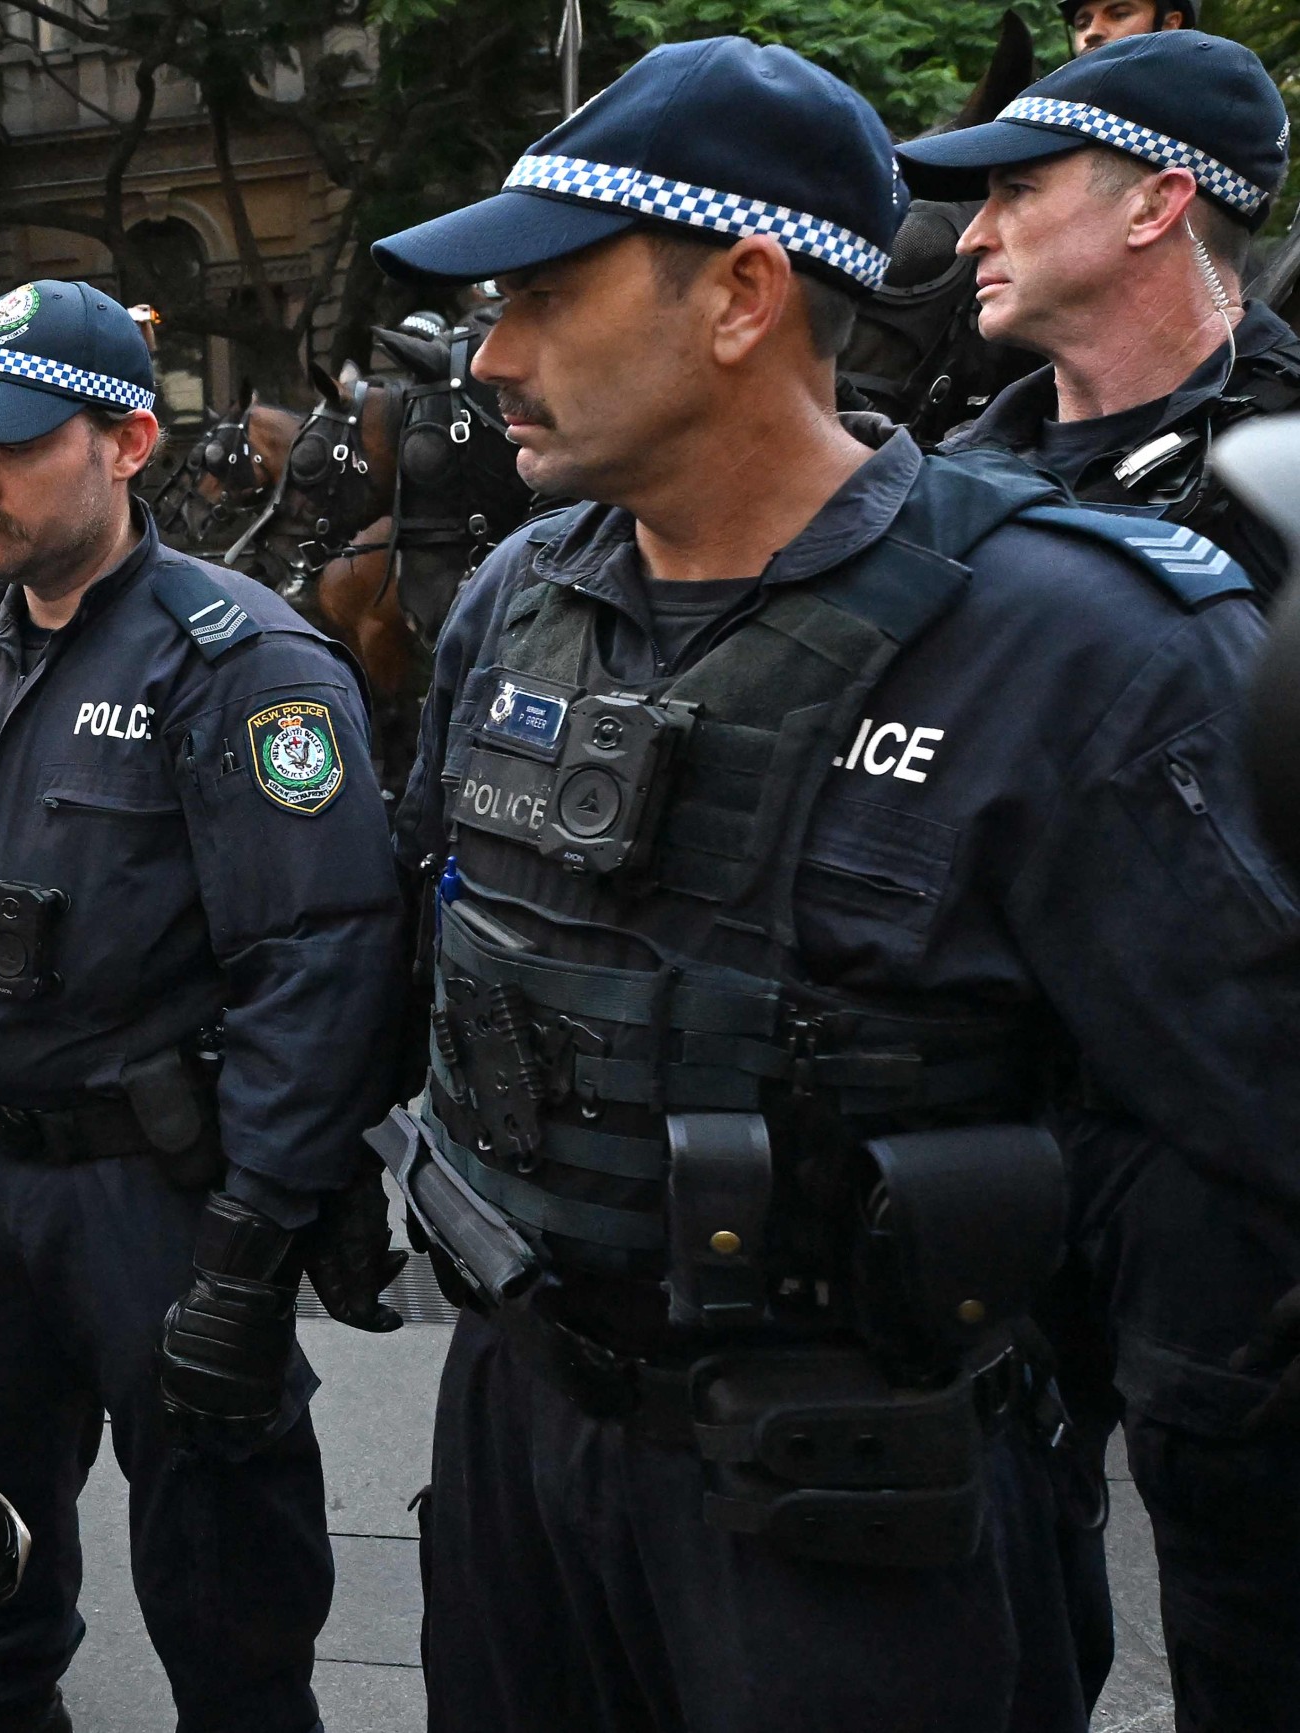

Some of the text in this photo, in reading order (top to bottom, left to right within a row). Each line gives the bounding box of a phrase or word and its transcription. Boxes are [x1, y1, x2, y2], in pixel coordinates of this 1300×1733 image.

[253, 706, 325, 728] N.S.W. POLICE
[518, 713, 525, 722] P
[525, 715, 548, 730] GREER
[272, 742, 281, 761] NEW
[278, 728, 303, 743] SOUTH
[830, 718, 945, 783] ICE
[277, 764, 303, 779] POLICE
[461, 779, 548, 830] POLICE
[563, 851, 585, 863] AXON
